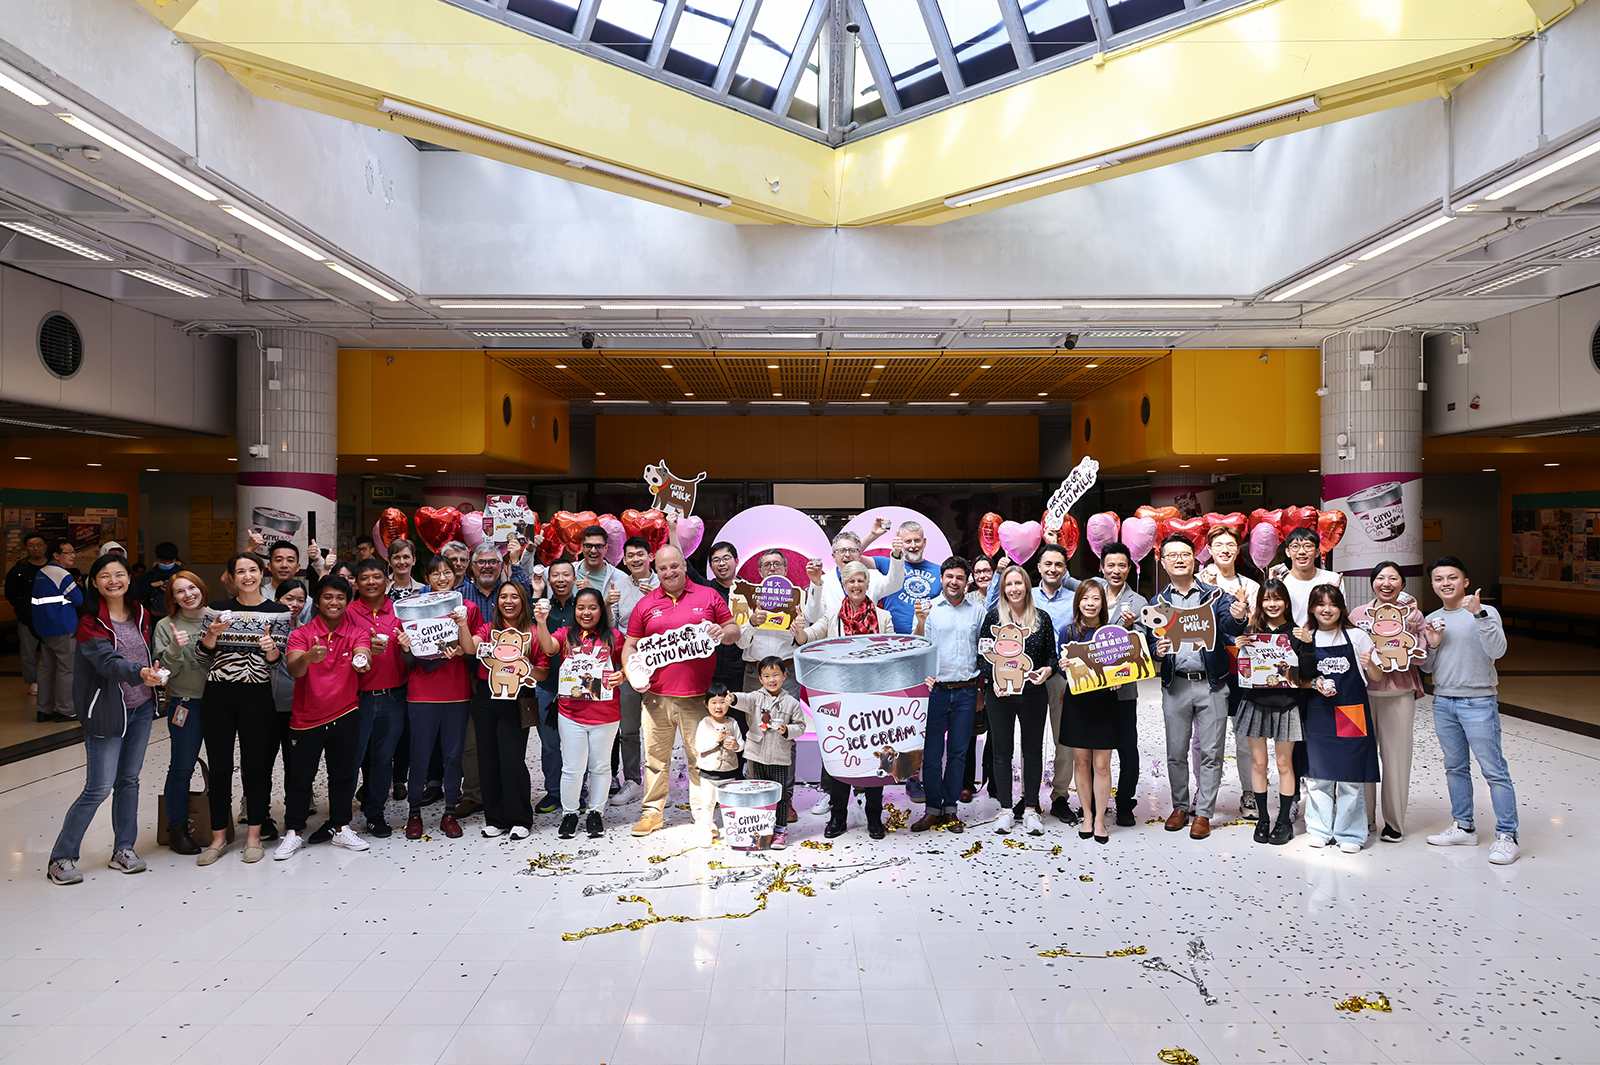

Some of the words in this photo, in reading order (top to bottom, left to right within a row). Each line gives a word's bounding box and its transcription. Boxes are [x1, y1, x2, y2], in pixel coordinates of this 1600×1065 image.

[766, 580, 781, 588] 城大
[1098, 631, 1115, 640] 城大
[1087, 650, 1106, 659] Fresh
[1106, 647, 1120, 655] milk
[1120, 644, 1135, 652] from
[1094, 655, 1113, 664] CityU
[1113, 651, 1131, 660] Farm
[846, 733, 868, 751] ICE
[870, 724, 917, 746] CREAM
